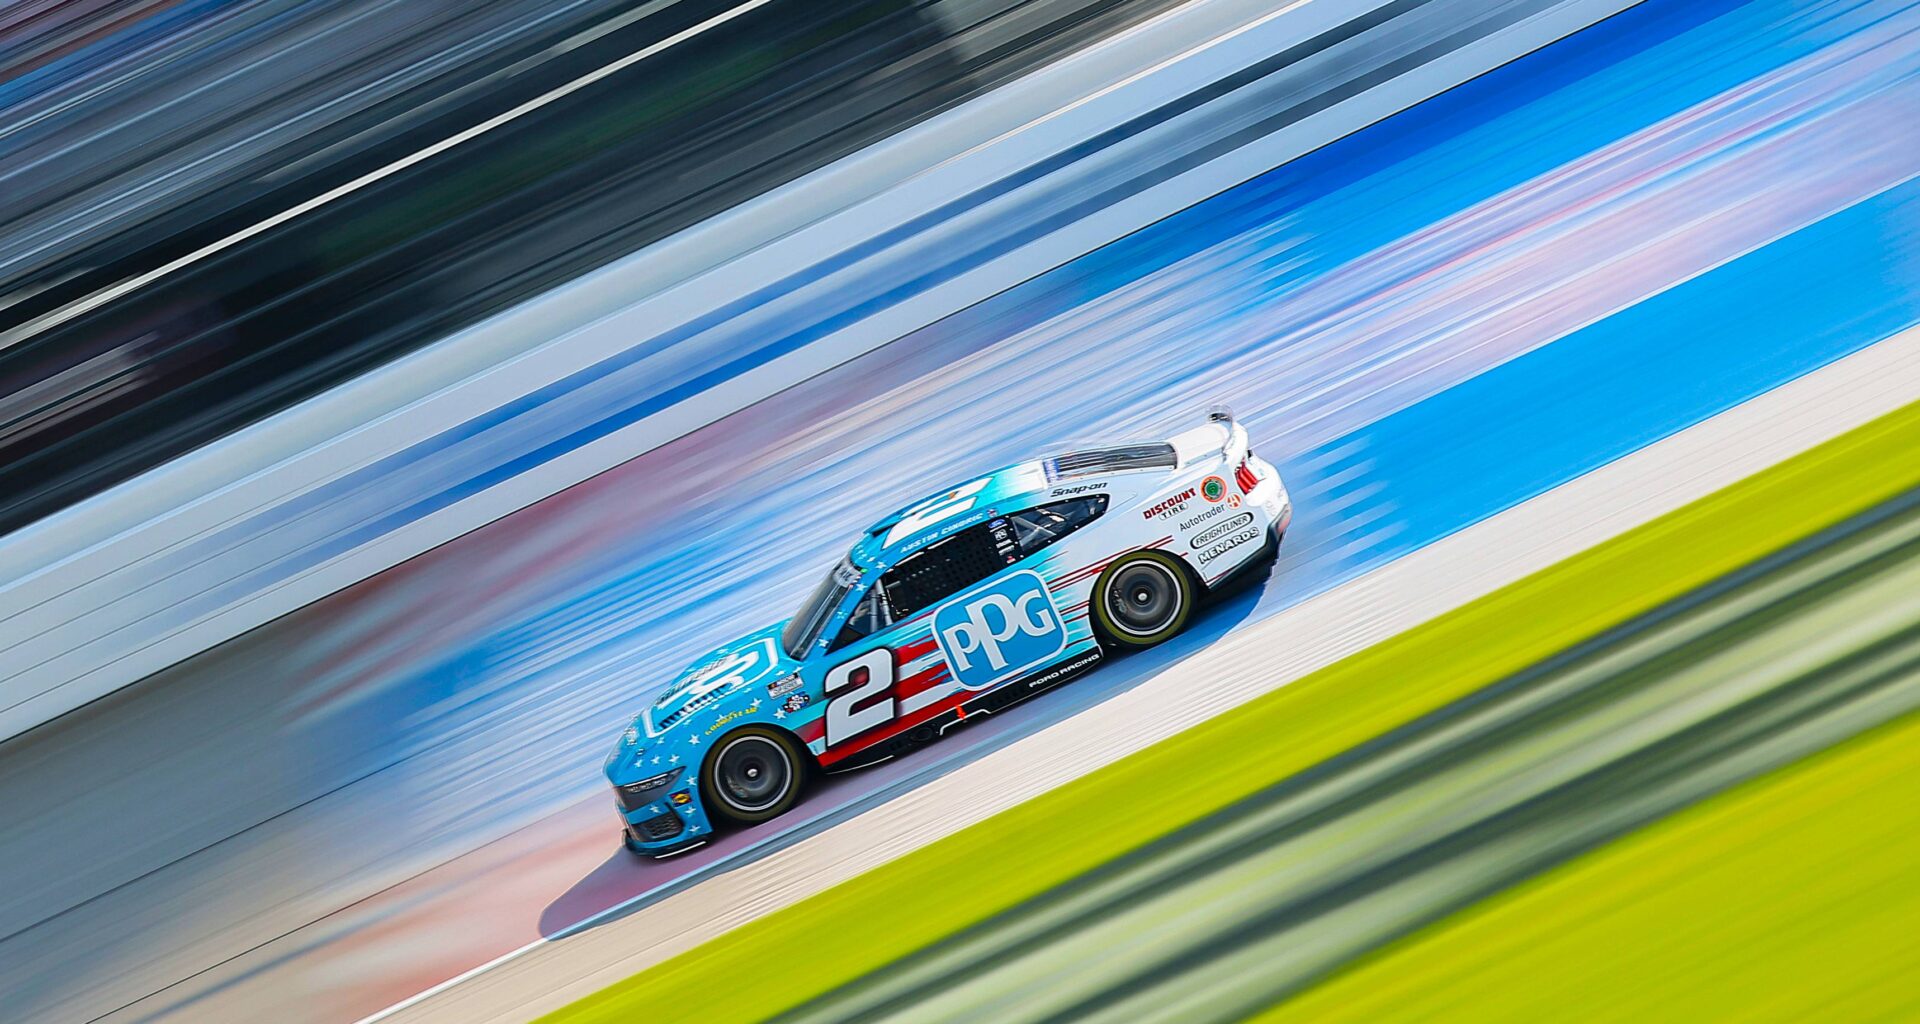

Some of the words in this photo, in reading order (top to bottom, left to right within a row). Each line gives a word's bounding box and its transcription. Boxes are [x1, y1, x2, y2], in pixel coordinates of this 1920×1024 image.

[1050, 482, 1108, 497] Snap-on
[1143, 487, 1196, 519] DISCOUNT
[1161, 503, 1185, 518] TIRE
[1179, 504, 1225, 531] Autotrader
[900, 532, 939, 553] AUSTIN
[1196, 515, 1248, 546] FREIGHTLINER
[1198, 527, 1260, 564] MENARDS
[942, 589, 1056, 672] PPG
[1028, 671, 1060, 688] FORD
[1059, 653, 1100, 675] RACING
[824, 647, 895, 748] 2
